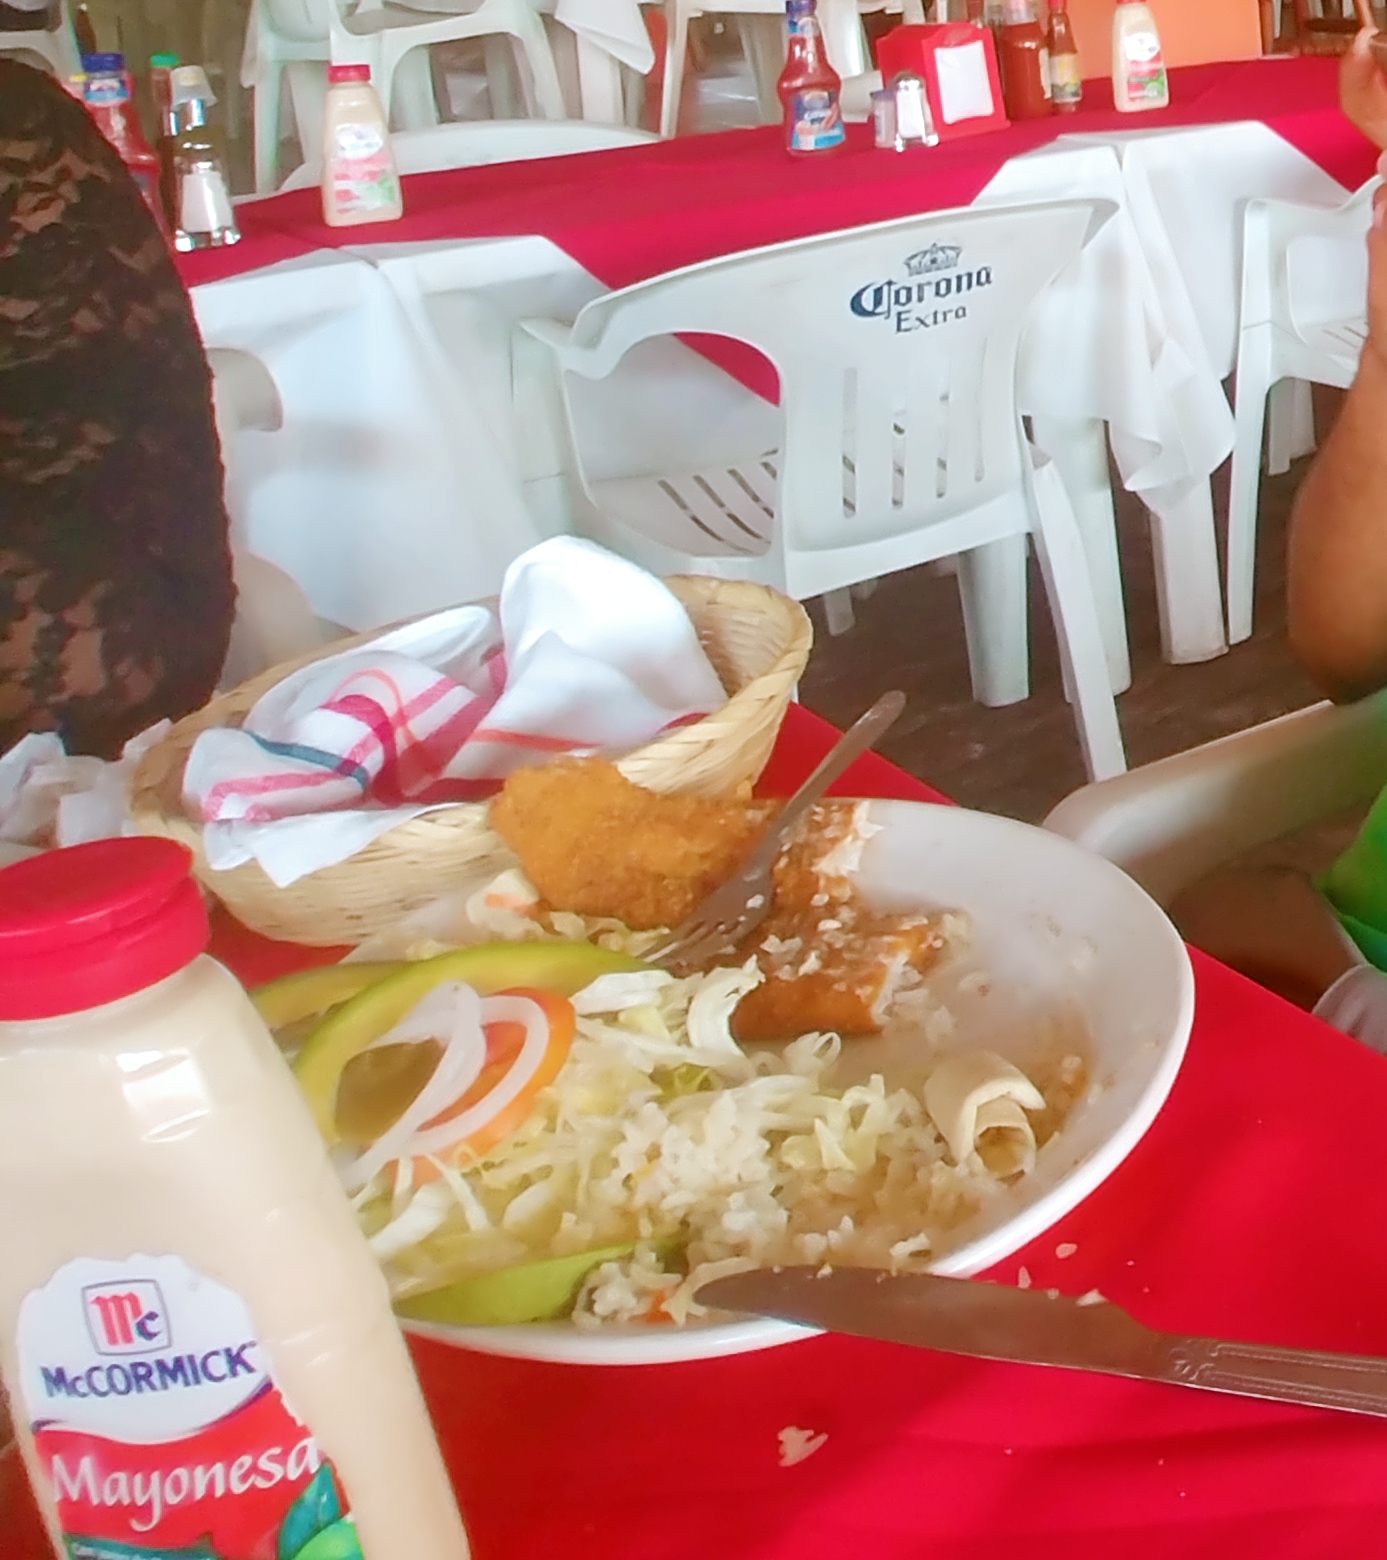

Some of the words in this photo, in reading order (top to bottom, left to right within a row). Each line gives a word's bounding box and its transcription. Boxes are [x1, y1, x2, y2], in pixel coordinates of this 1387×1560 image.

[849, 265, 994, 321] Corona
[895, 305, 968, 333] Extra
[39, 1341, 258, 1399] McCORMICK
[51, 1436, 321, 1533] Mayonesa
